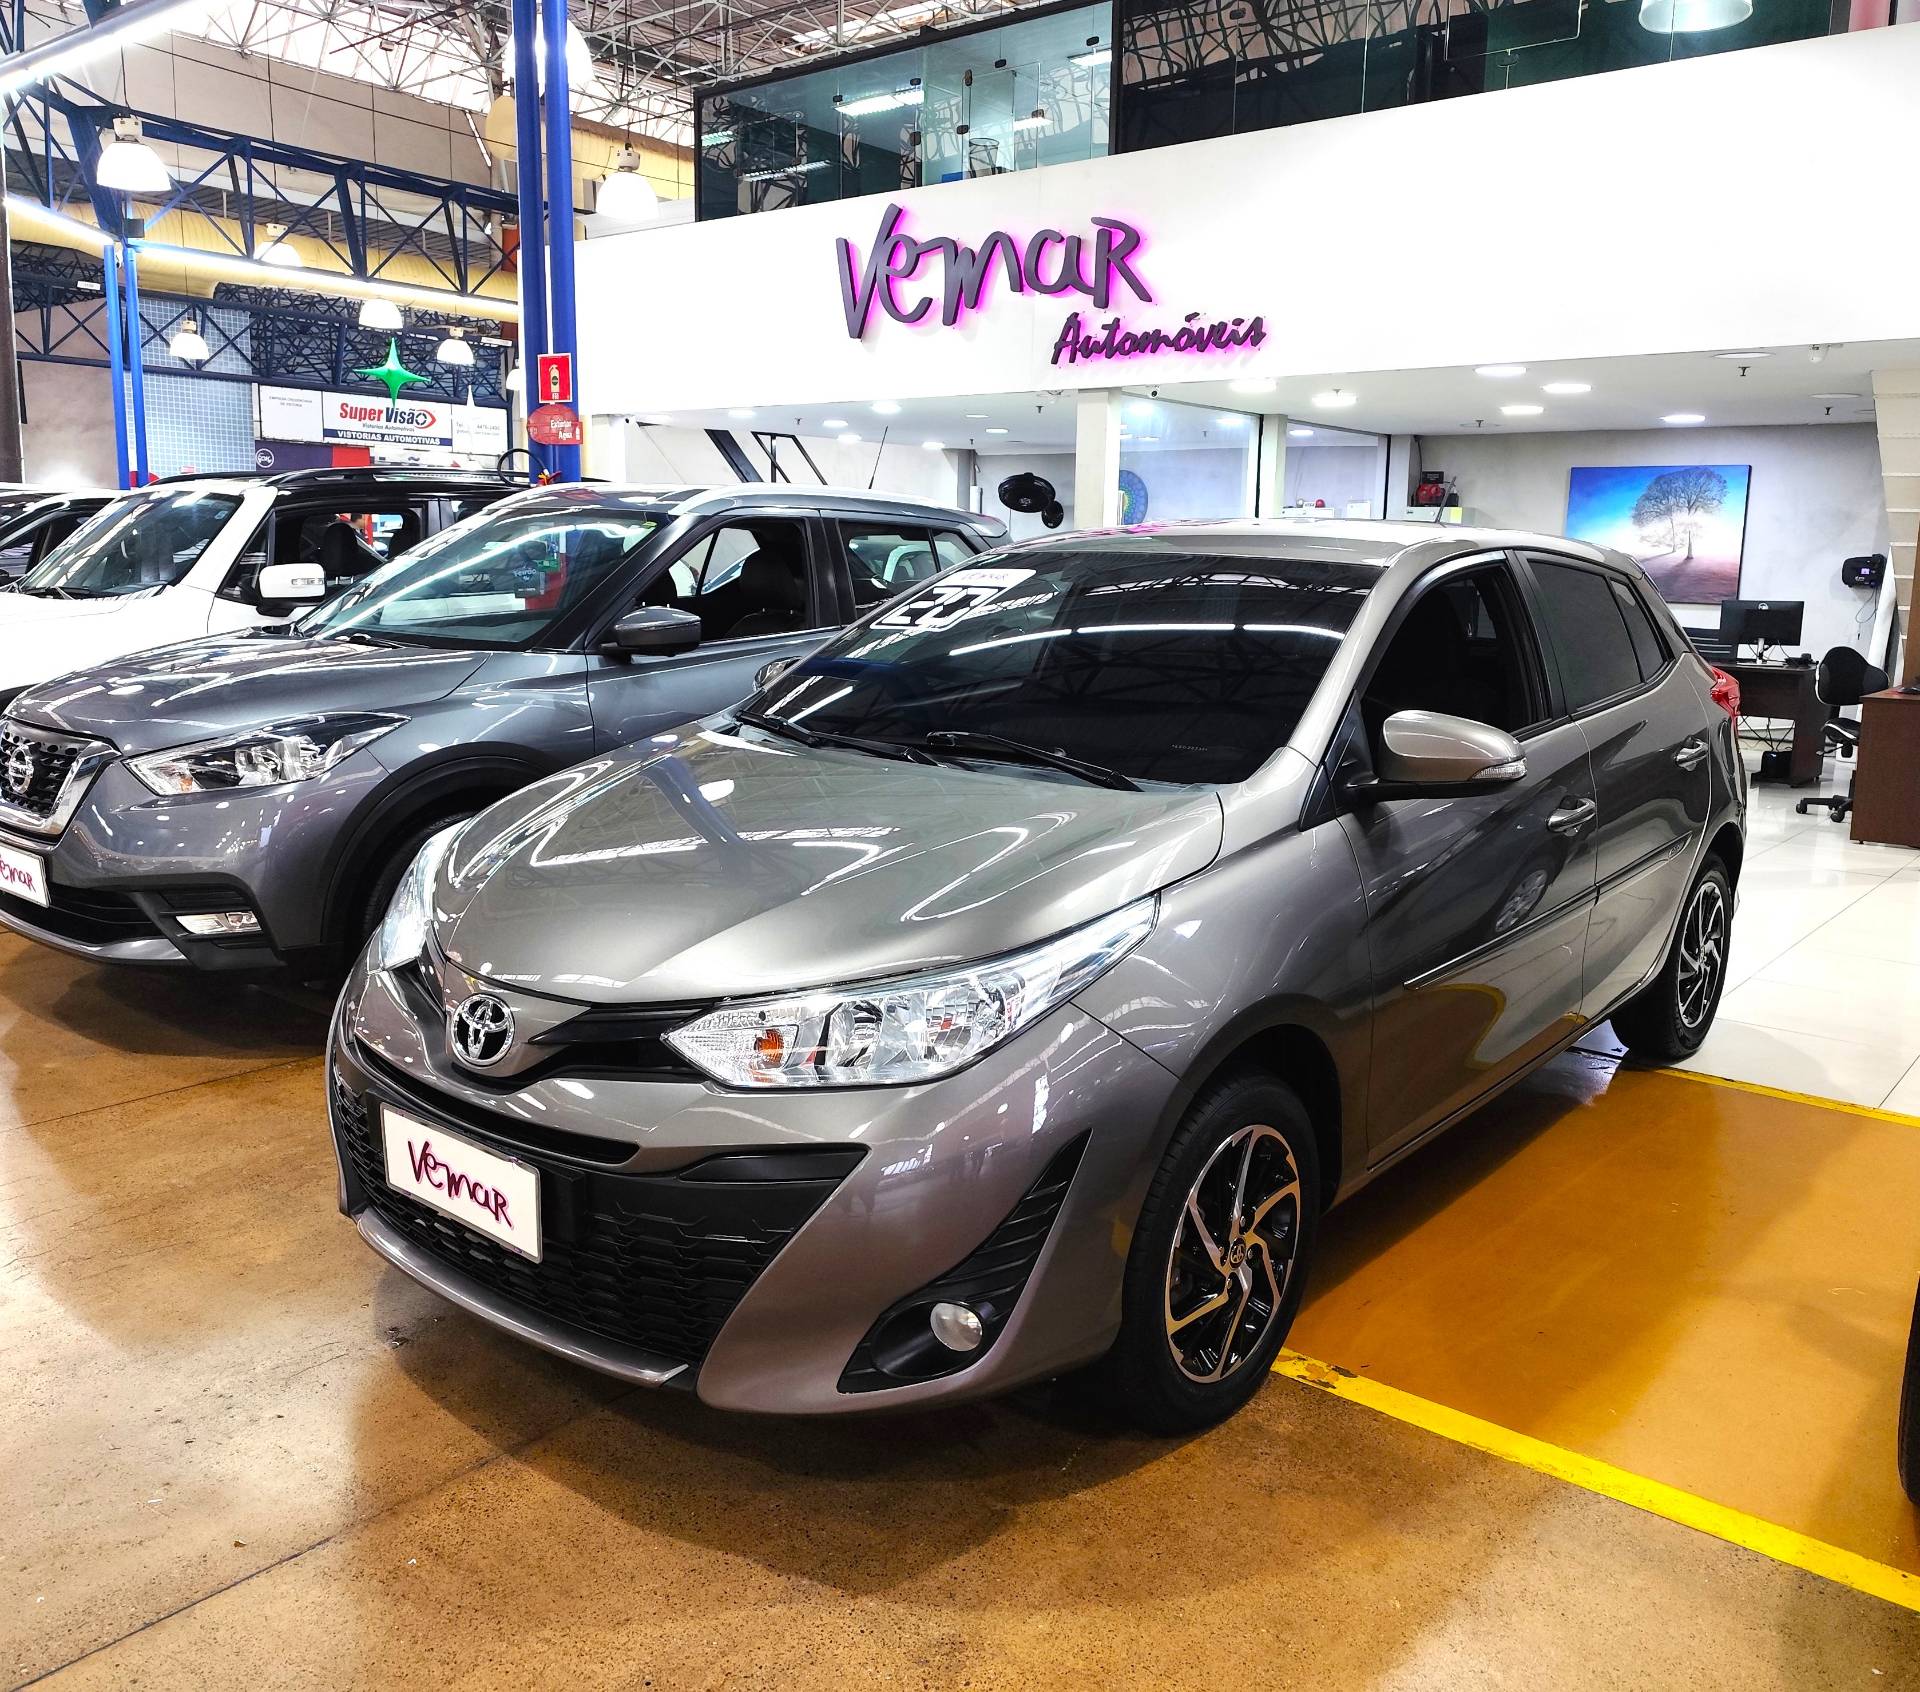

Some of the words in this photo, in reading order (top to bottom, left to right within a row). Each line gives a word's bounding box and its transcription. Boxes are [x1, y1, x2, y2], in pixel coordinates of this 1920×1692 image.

[1051, 312, 1267, 365] Automóveis
[340, 403, 384, 422] Super
[385, 407, 428, 426] Visão
[337, 430, 382, 440] VISTORIAS
[384, 434, 441, 445] AUTOMOTIVAS
